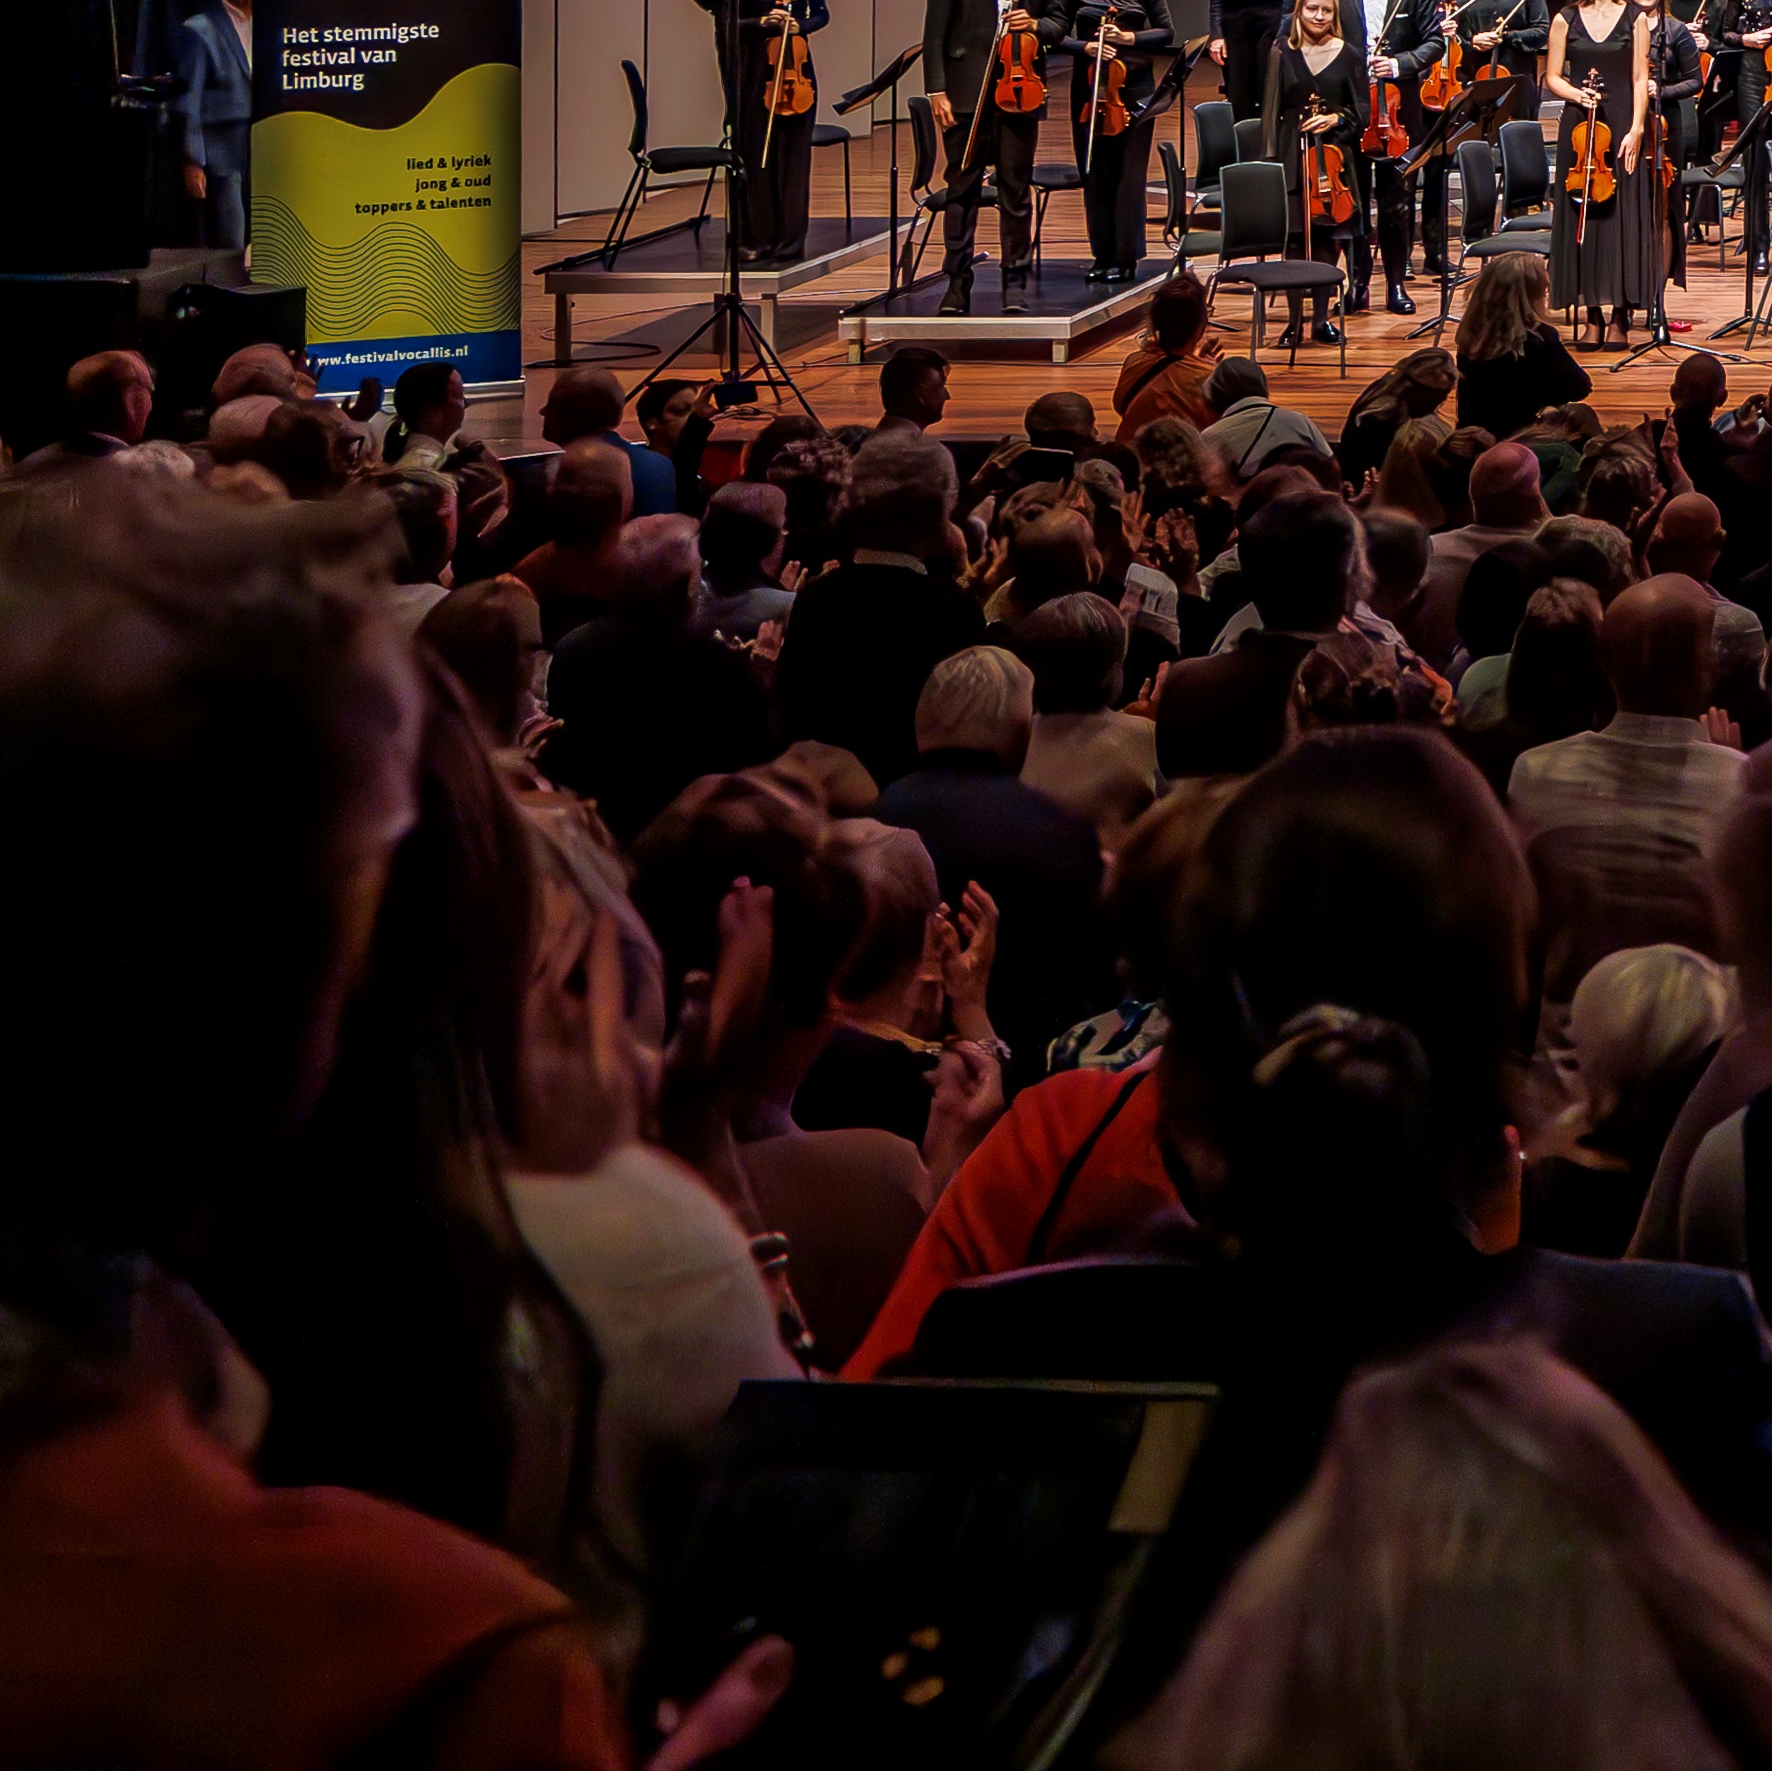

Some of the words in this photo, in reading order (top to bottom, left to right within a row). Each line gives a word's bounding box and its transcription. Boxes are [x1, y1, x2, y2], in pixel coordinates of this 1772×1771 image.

[282, 27, 319, 44] Het
[323, 23, 440, 43] stemmigste
[282, 47, 356, 67] festival
[360, 49, 397, 63] van
[282, 71, 365, 91] Limburg
[406, 157, 434, 170] lied
[437, 157, 447, 169] &
[451, 154, 492, 171] lyriek
[415, 178, 447, 193] jong
[450, 177, 461, 188] &
[464, 174, 491, 187] oud
[354, 201, 413, 216] toppers
[416, 199, 426, 210] &
[430, 196, 492, 209] talenten
